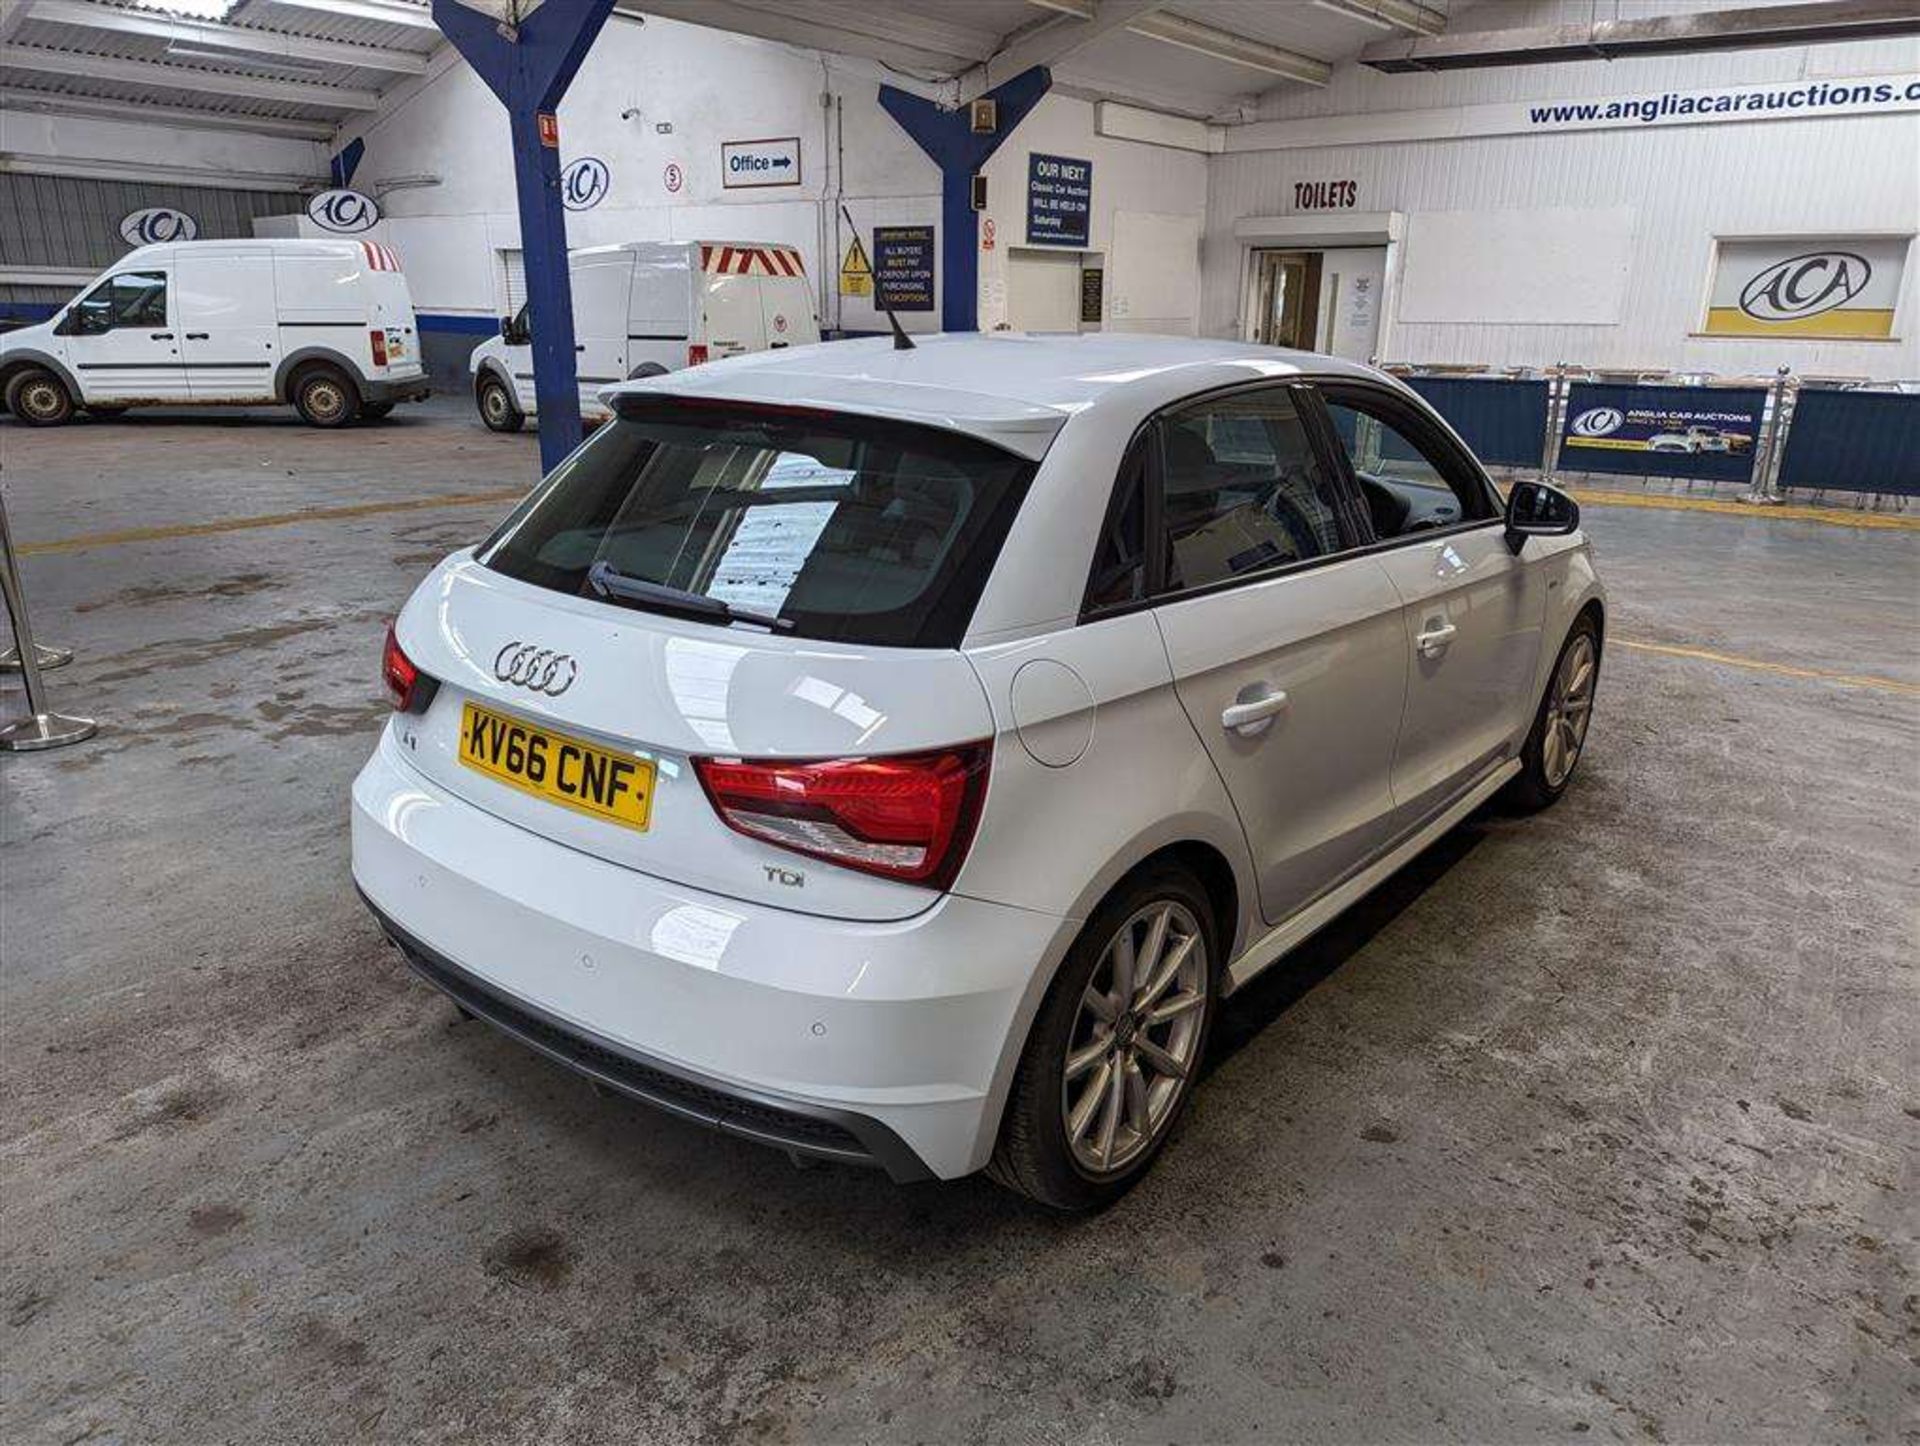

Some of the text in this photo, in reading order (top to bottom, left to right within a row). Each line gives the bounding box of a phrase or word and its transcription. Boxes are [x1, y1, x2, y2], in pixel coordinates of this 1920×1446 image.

[730, 155, 769, 172] Office
[1037, 160, 1086, 181] OUR NEXT
[669, 168, 677, 182] 5
[1032, 197, 1049, 209] WILL
[1050, 199, 1059, 210] BE
[1076, 202, 1087, 212] ON
[1295, 180, 1357, 209] TOILETS
[310, 193, 371, 227] ACA
[124, 211, 191, 242] ACA
[1744, 257, 1852, 312] ACA
[1574, 410, 1619, 432] ACA
[1626, 409, 1752, 422] ANGLIA CAR AUCTIONS
[468, 710, 635, 808] KV66 CNF
